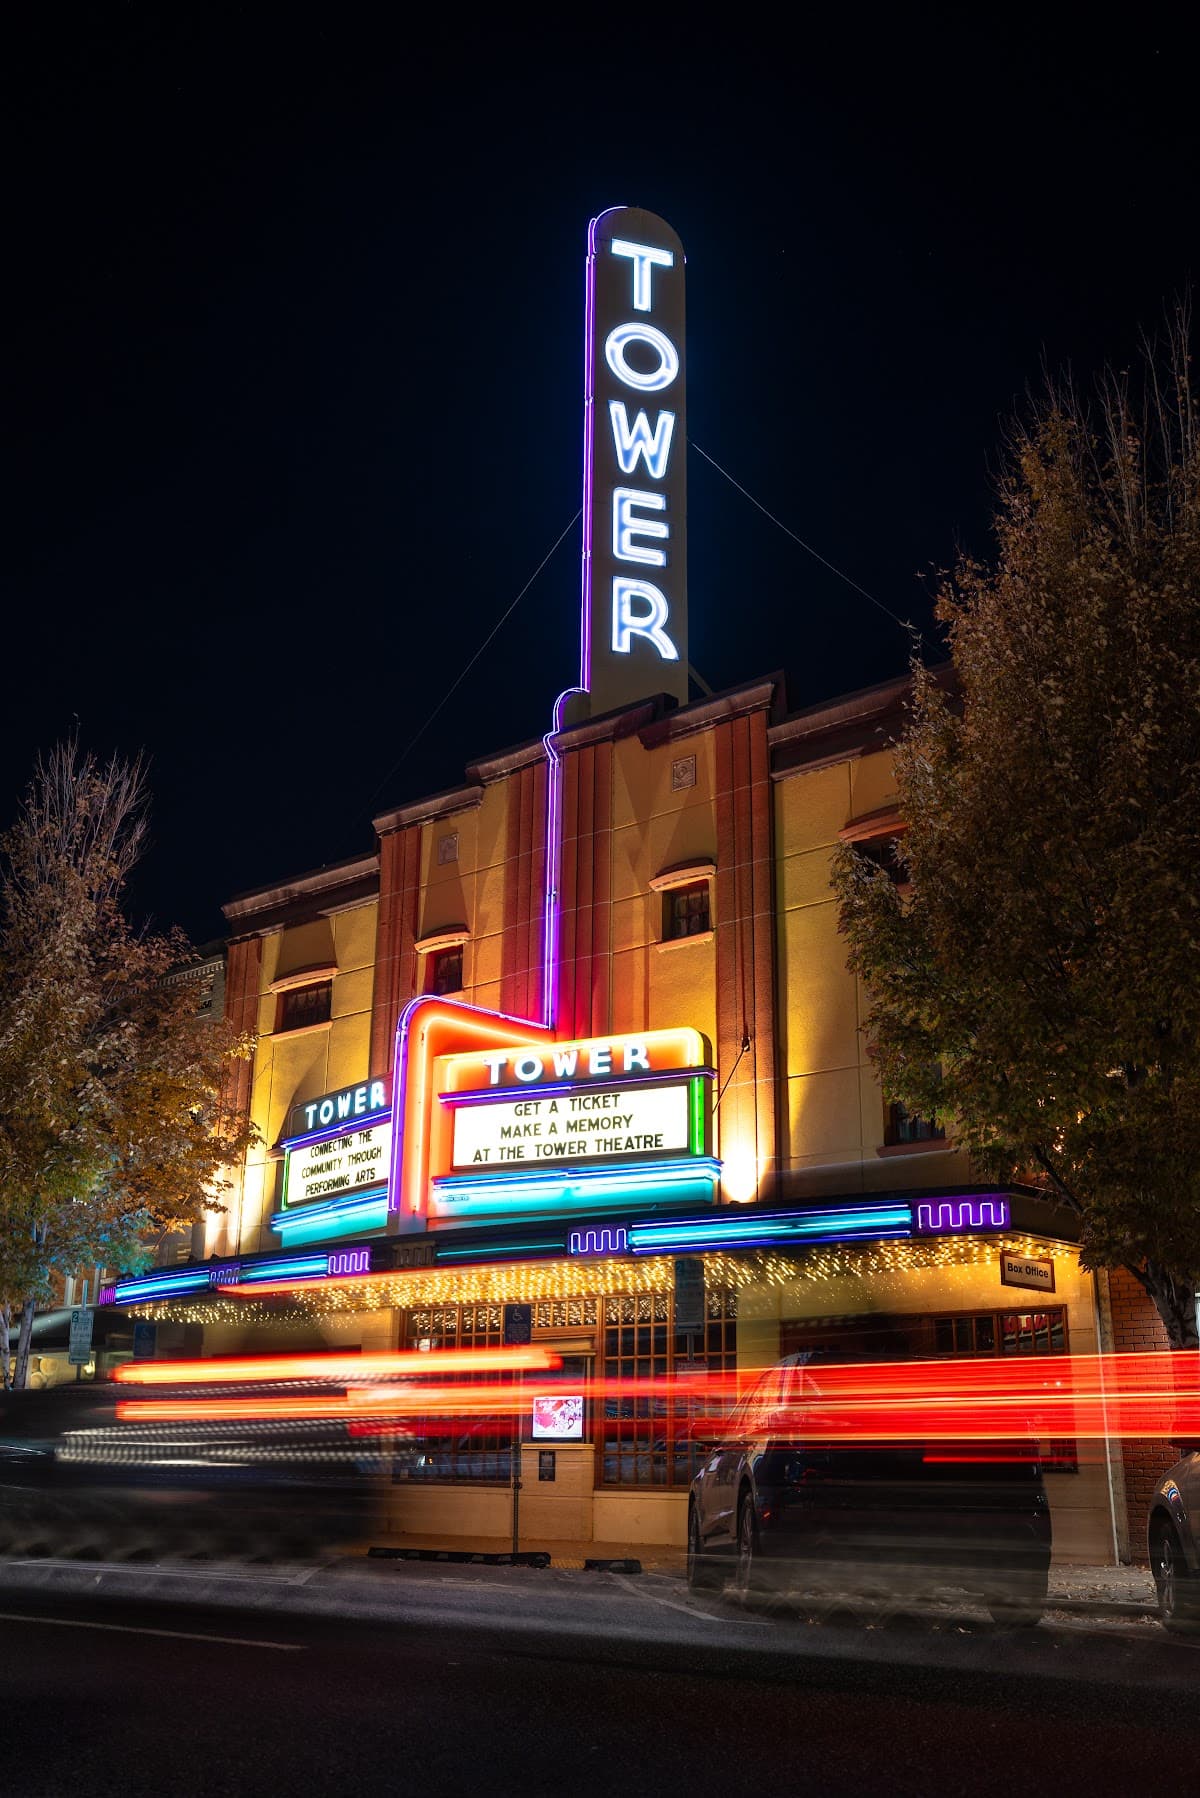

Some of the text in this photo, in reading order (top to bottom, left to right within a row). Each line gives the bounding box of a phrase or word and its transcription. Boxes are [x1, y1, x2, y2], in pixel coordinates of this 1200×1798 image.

[605, 238, 680, 660] TOWER
[483, 1040, 650, 1085] TOWER
[305, 1081, 385, 1129] TOWER
[514, 1094, 621, 1116] GET A TICKET
[500, 1114, 633, 1139] MAKE A MEMORY
[310, 1129, 373, 1158] CONNECTING THE
[473, 1133, 664, 1162] AT THE TOWER THEATRE
[301, 1146, 382, 1179] COMMUNITY THROUGH
[305, 1168, 375, 1196] PERFORMING ARTS
[1007, 1263, 1049, 1278] Box Office
[72, 1312, 79, 1321] 2
